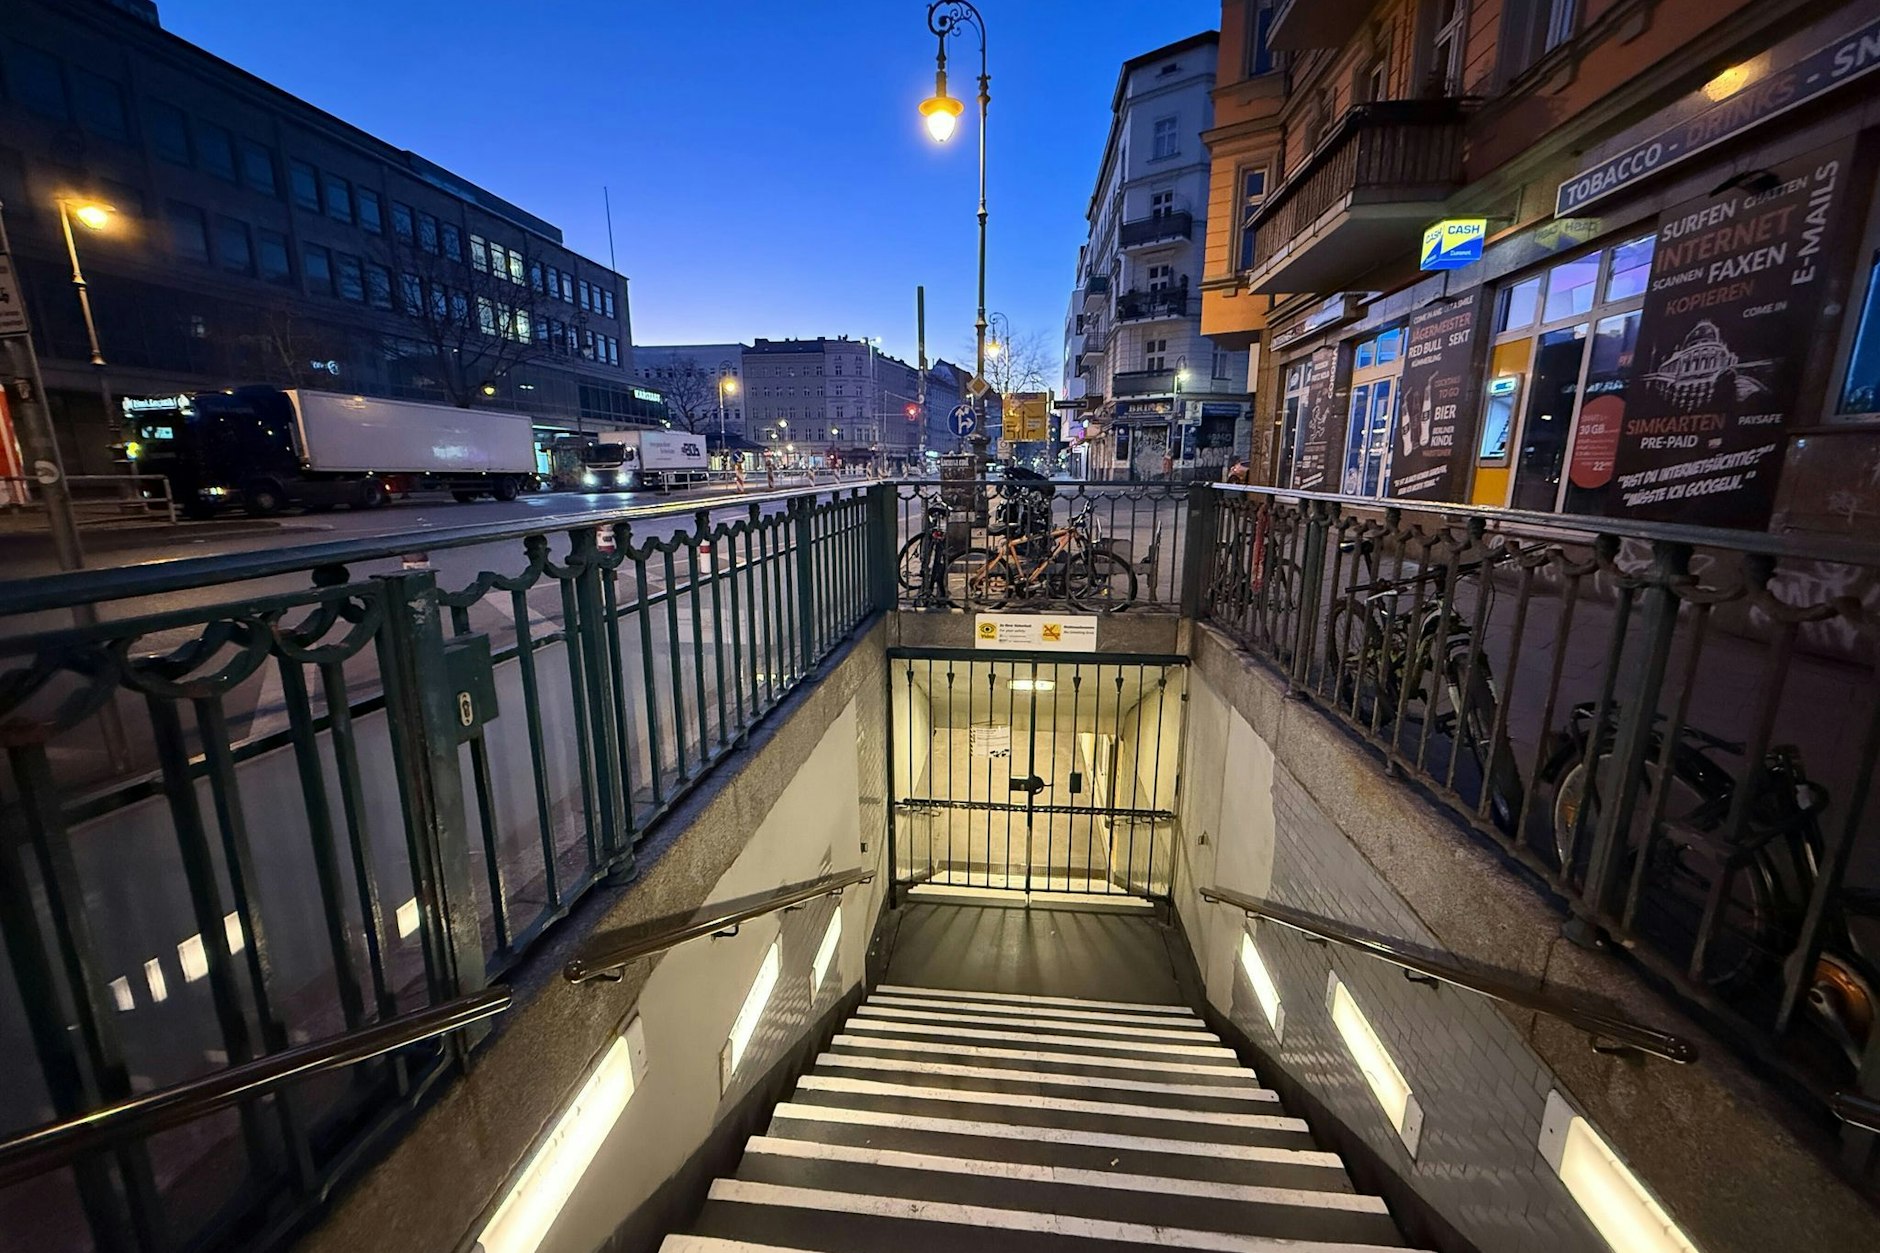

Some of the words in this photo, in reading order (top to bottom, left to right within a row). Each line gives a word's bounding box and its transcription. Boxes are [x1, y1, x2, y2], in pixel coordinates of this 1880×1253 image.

[1567, 142, 1662, 206] TOBACCO
[1685, 73, 1797, 144] DRINKS
[1661, 199, 1737, 242] SURFEN
[1743, 176, 1809, 210] CHATTEN
[1448, 225, 1480, 235] CASH
[1791, 160, 1840, 286] E-MAILS
[1655, 204, 1798, 274] INTERNET
[1651, 267, 1704, 292] SCANNEN
[1707, 242, 1788, 284] FAXEN
[1664, 280, 1754, 317] KOPIEREN
[1774, 301, 1788, 312] IN
[1408, 345, 1423, 359] RED
[1423, 338, 1442, 354] BULL
[1448, 329, 1471, 346] SEKT
[1434, 404, 1456, 420] BIER
[1591, 424, 1605, 434] GB
[1627, 414, 1726, 435] SIMKARTEN
[1738, 414, 1783, 425] PAYSAFE
[1431, 435, 1453, 447] KINDL
[1640, 435, 1698, 449] PRE-PAID
[1667, 483, 1684, 500] ICH
